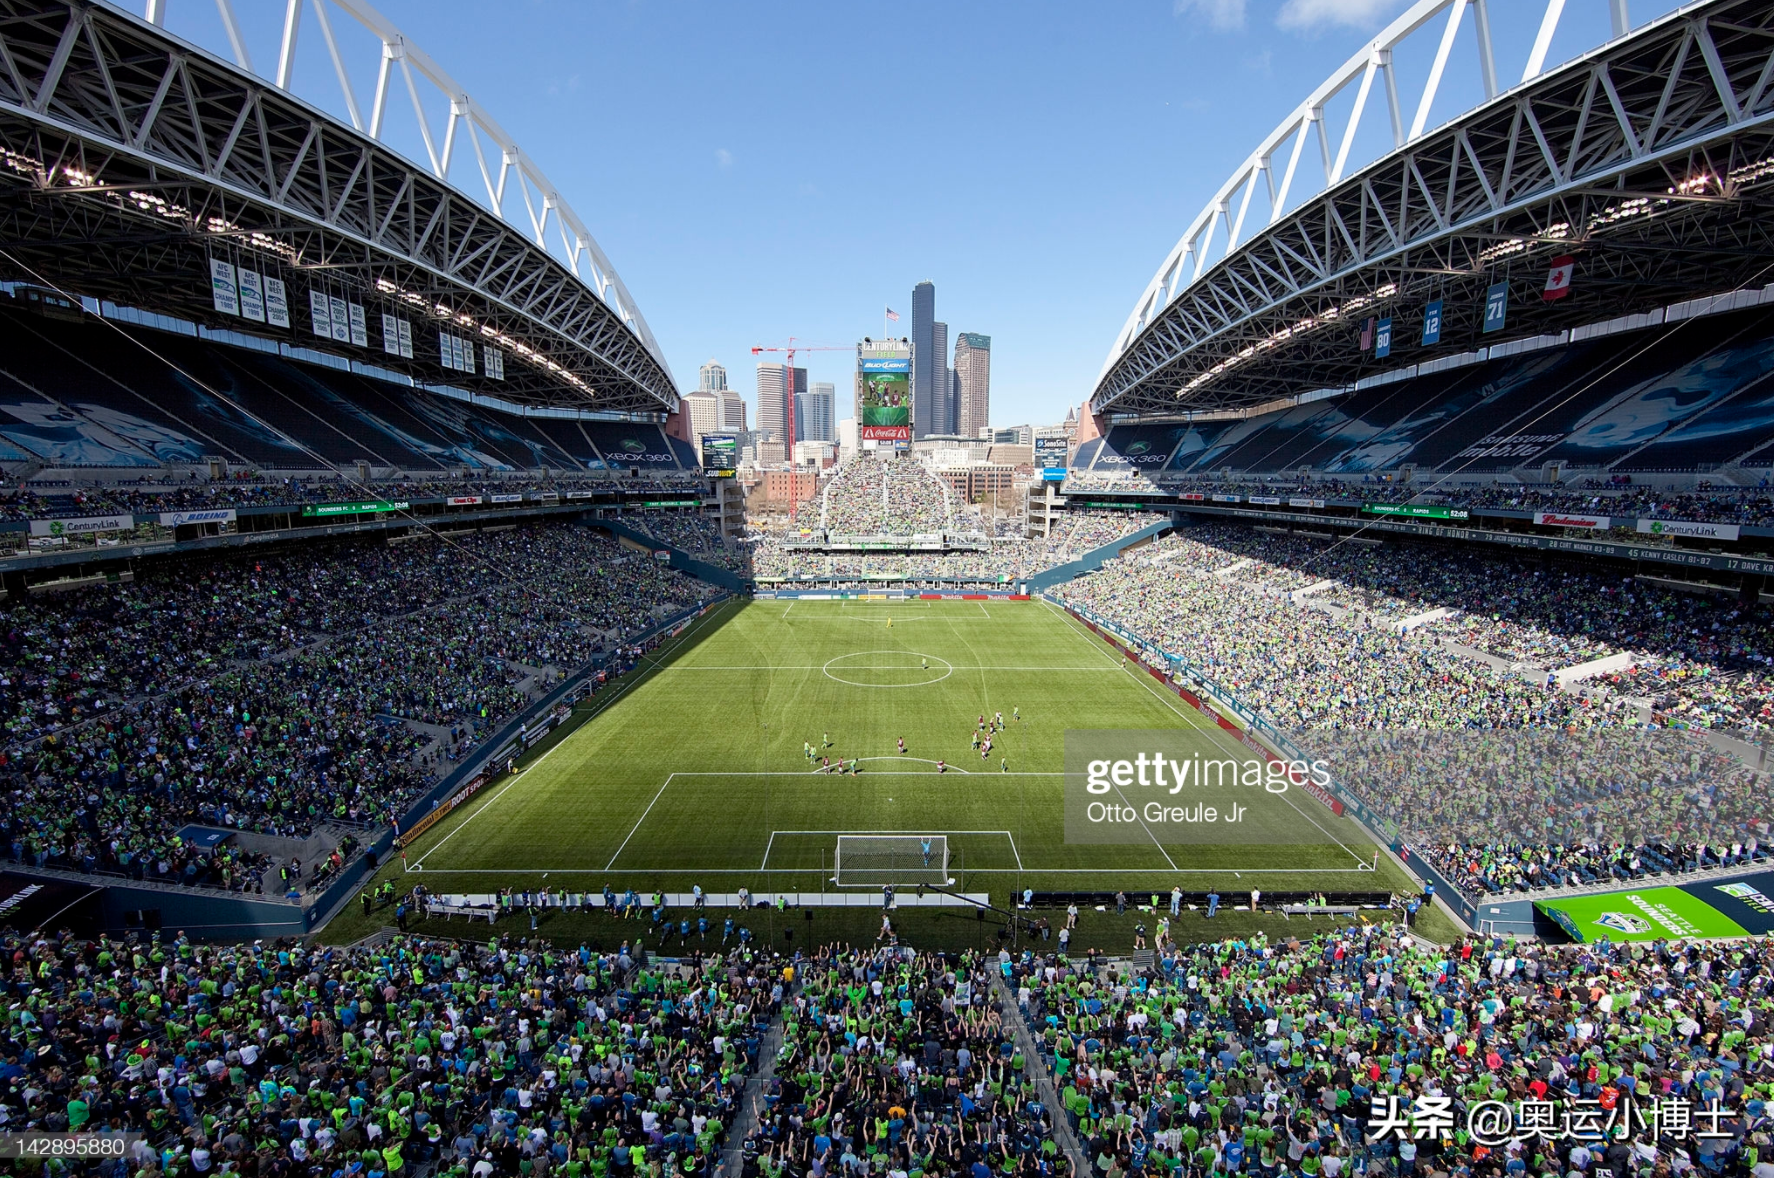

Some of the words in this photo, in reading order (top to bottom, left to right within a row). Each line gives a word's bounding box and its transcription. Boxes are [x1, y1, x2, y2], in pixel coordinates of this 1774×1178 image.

[217, 263, 228, 272] AFC
[216, 269, 230, 279] WEST
[244, 271, 255, 280] AFC
[243, 278, 257, 287] WEST
[268, 286, 282, 295] WEST
[215, 292, 237, 304] CHAMPS
[243, 300, 262, 311] CHAMPS
[268, 305, 288, 317] CHAMPS
[1488, 301, 1503, 321] 71
[1425, 318, 1438, 335] 12
[864, 342, 909, 351] CENTURYLINK
[1377, 333, 1389, 348] 80
[1043, 439, 1067, 447] SonoSite
[604, 452, 646, 461] XBOX
[645, 454, 673, 462] 360
[1098, 455, 1138, 464] XBOX
[1138, 454, 1167, 463] 360
[187, 511, 229, 521] BOEING
[1450, 510, 1468, 518] 52:08
[67, 519, 120, 531] CenturyLink
[1541, 514, 1597, 527] Budweiser
[1418, 526, 1433, 535] RING
[1436, 528, 1444, 536] OF
[1447, 529, 1469, 539] HONOR
[1663, 524, 1717, 537] CenturyLink
[1549, 540, 1558, 548] 28
[1573, 543, 1593, 552] WARNER
[1594, 544, 1615, 554] 83-89
[1628, 549, 1639, 557] 45
[1641, 551, 1661, 559] KENNY
[1662, 552, 1686, 563] EASLEY
[1688, 556, 1711, 566] 81-87
[1728, 560, 1738, 569] 17
[1741, 561, 1760, 571] DAVE
[1199, 701, 1219, 724] Makita
[1241, 733, 1268, 760] Makita
[451, 787, 470, 808] ROOT
[402, 815, 435, 845] Continental
[438, 802, 451, 816] TIRE
[1739, 896, 1769, 913] FIELD
[1626, 895, 1688, 935] SOUNDERS
[1654, 903, 1703, 934] SEATTLE
